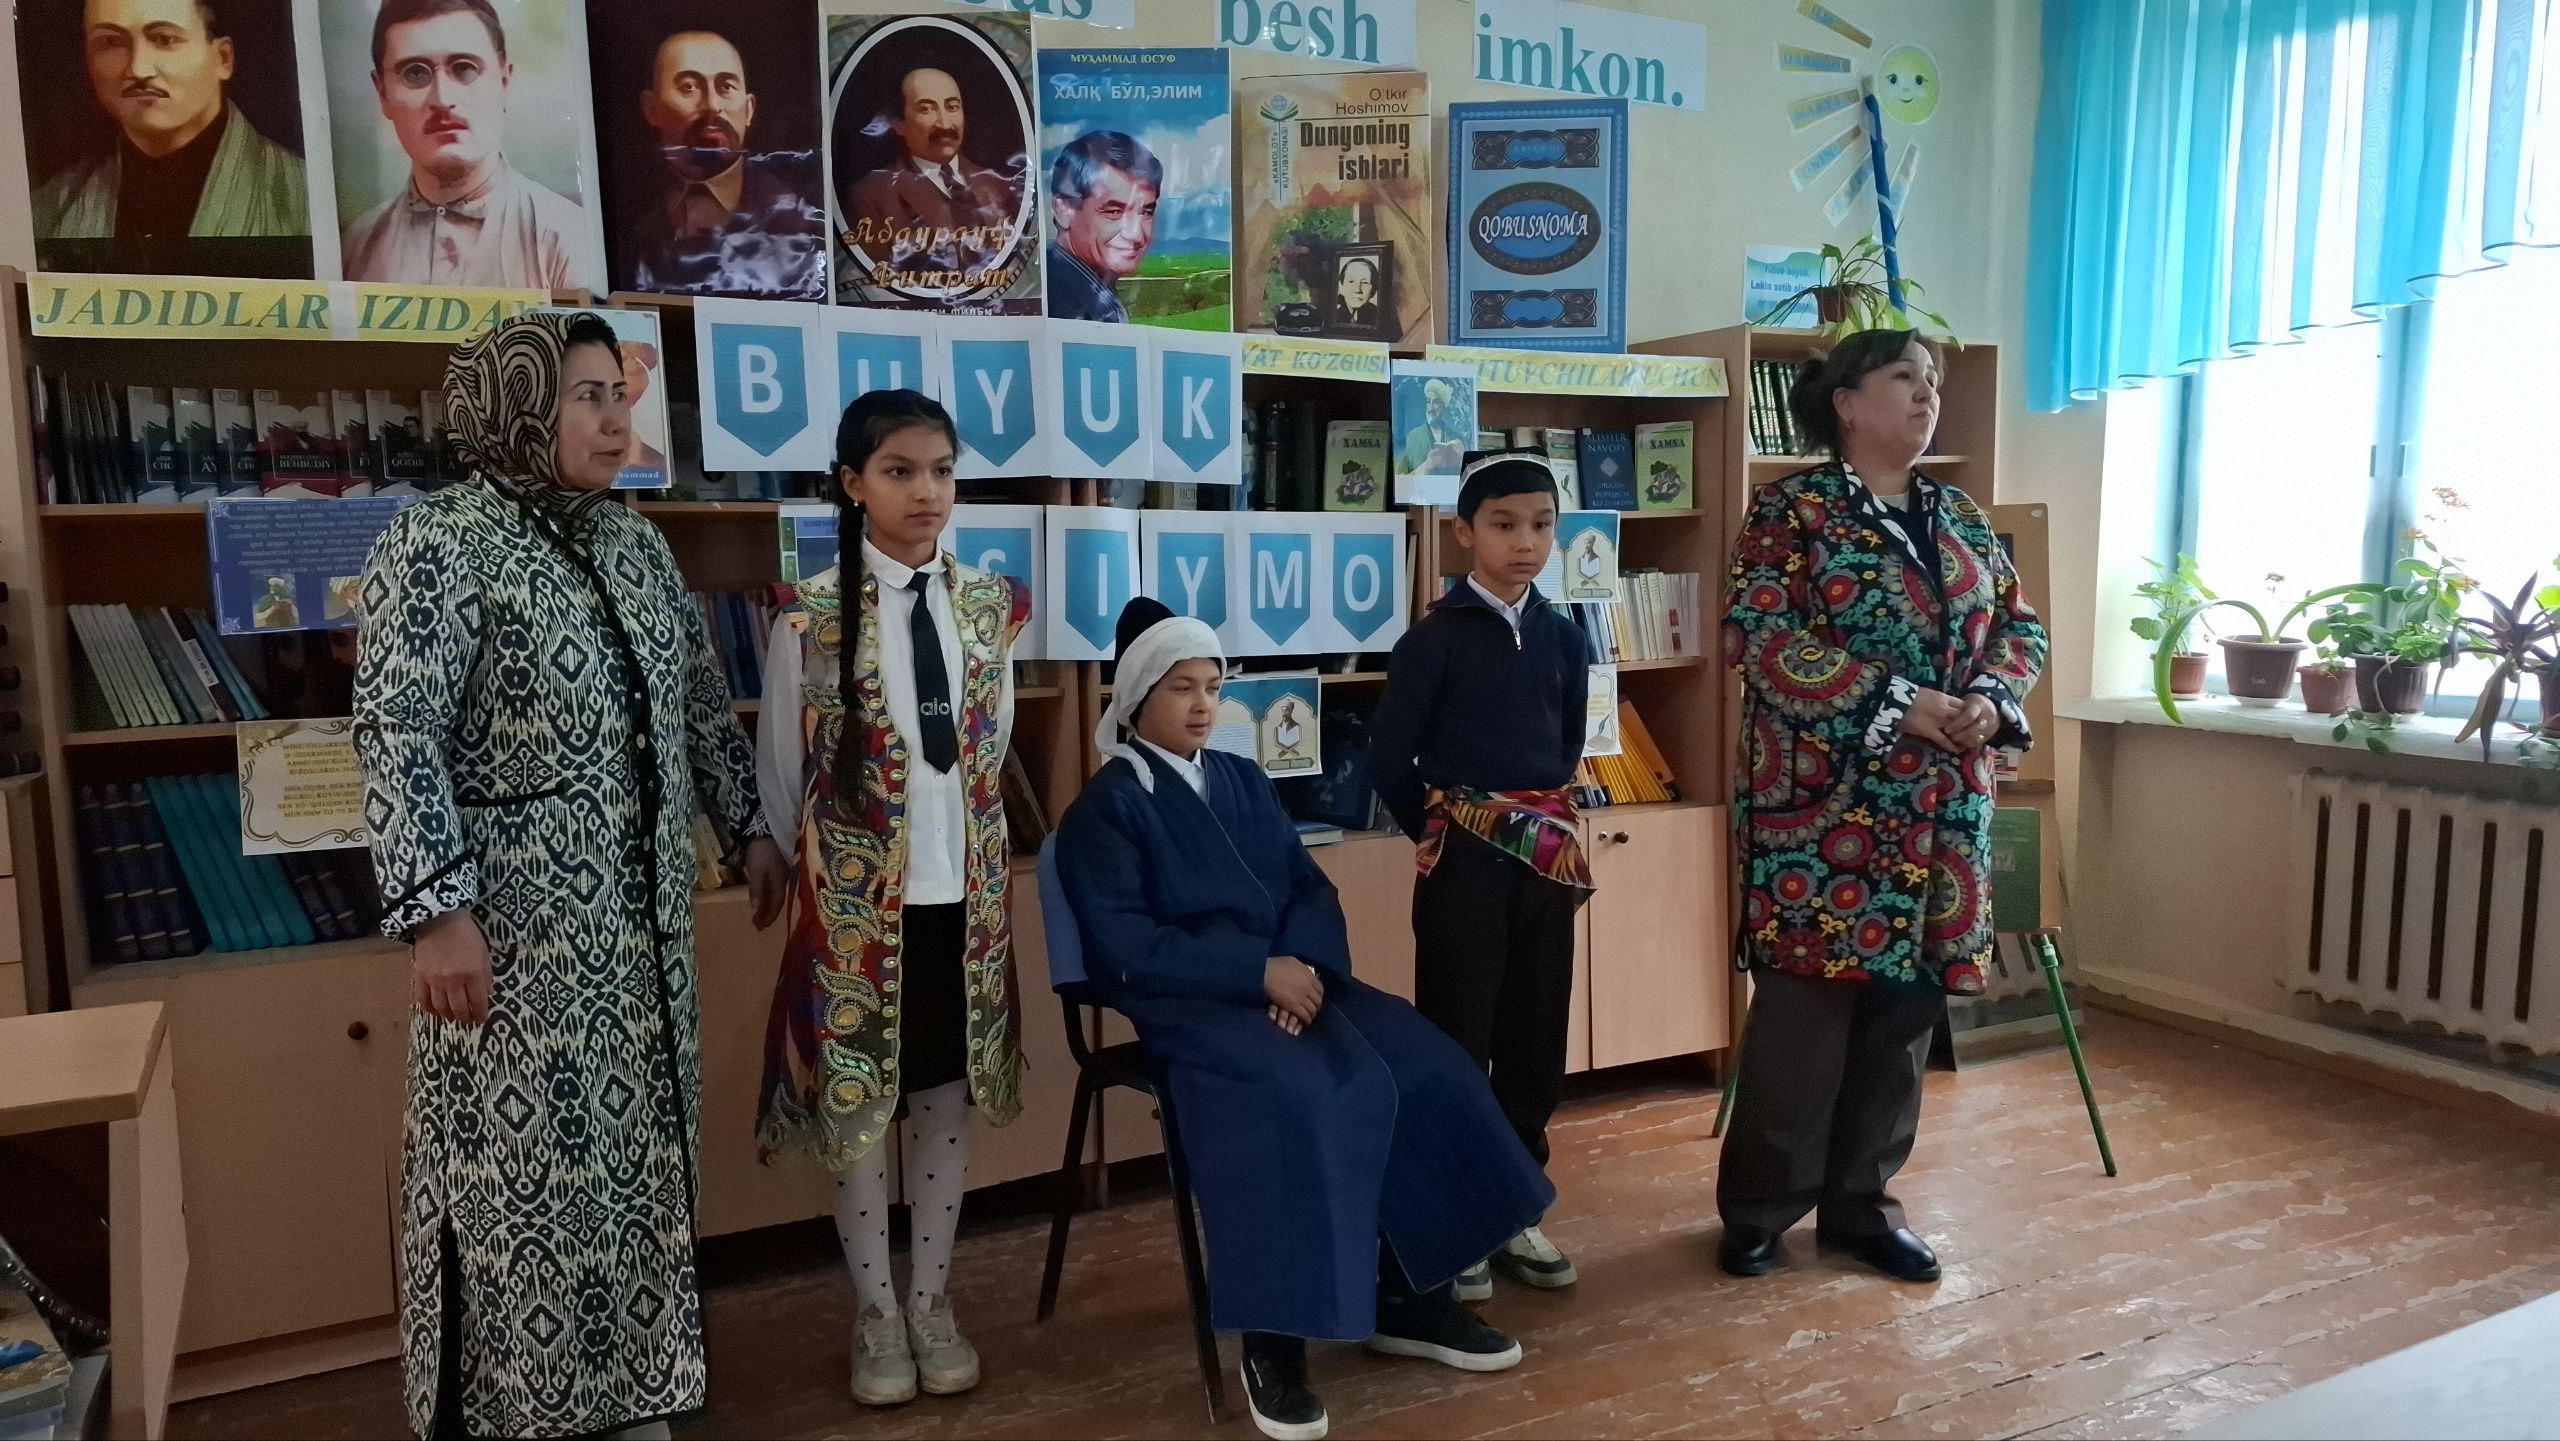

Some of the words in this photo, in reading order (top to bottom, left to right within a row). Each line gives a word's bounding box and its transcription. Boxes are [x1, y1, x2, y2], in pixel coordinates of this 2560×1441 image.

[1140, 53, 1177, 64] ЮСУФ
[1219, 0, 1381, 64] besh
[1474, 12, 1685, 107] imkon.
[1335, 102, 1408, 116] Hoshimov
[1300, 118, 1410, 153] Dunyoning
[1338, 152, 1410, 181] ishlari
[1478, 210, 1589, 244] QOBUSNOMA
[35, 286, 330, 330] JADIDLAR
[356, 293, 546, 333] IZIDA
[1342, 438, 1382, 449] XAMSA
[1649, 438, 1686, 450] XAMSA
